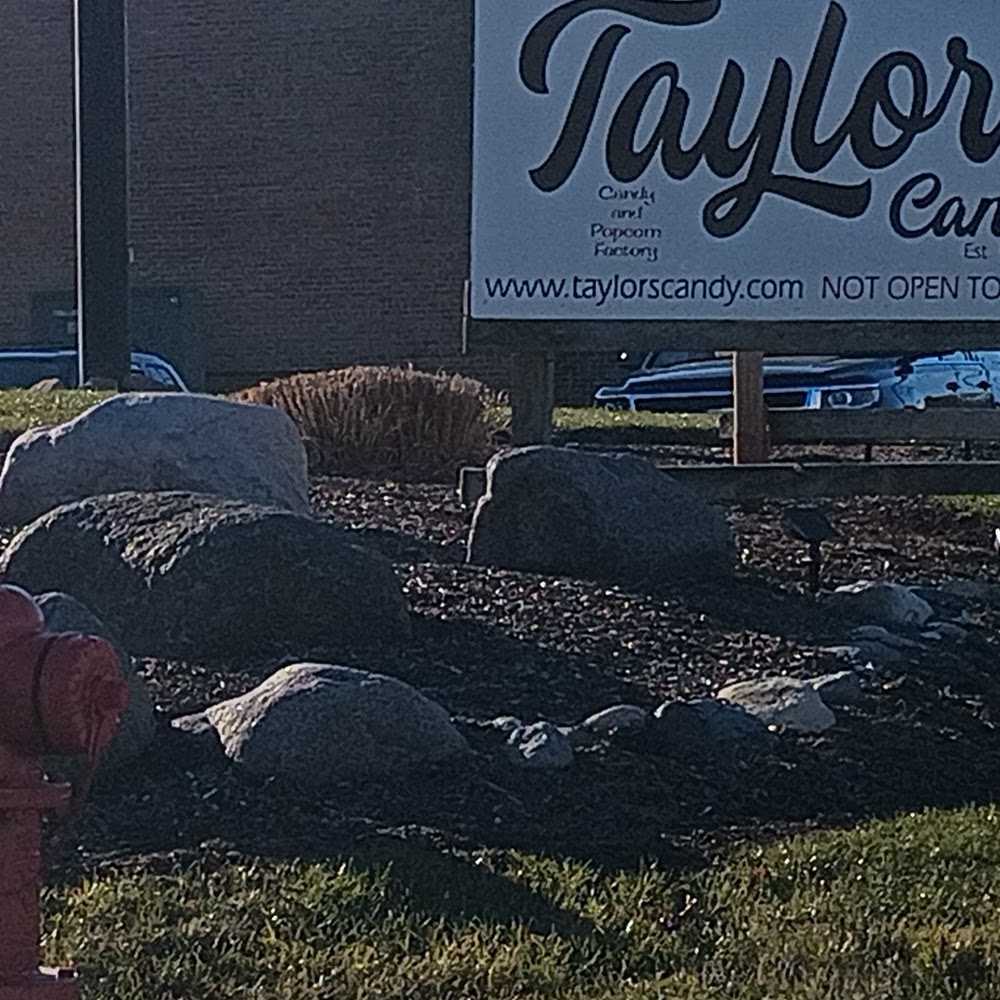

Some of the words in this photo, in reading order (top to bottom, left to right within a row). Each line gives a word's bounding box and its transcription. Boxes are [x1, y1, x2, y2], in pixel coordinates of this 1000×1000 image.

[598, 185, 655, 206] Candy
[611, 206, 643, 219] and
[594, 241, 658, 262] Factory
[486, 275, 803, 307] www.taylorscandy.com
[822, 276, 880, 299] NOT
[887, 276, 959, 299] OPEN
[967, 276, 1000, 299] TO
